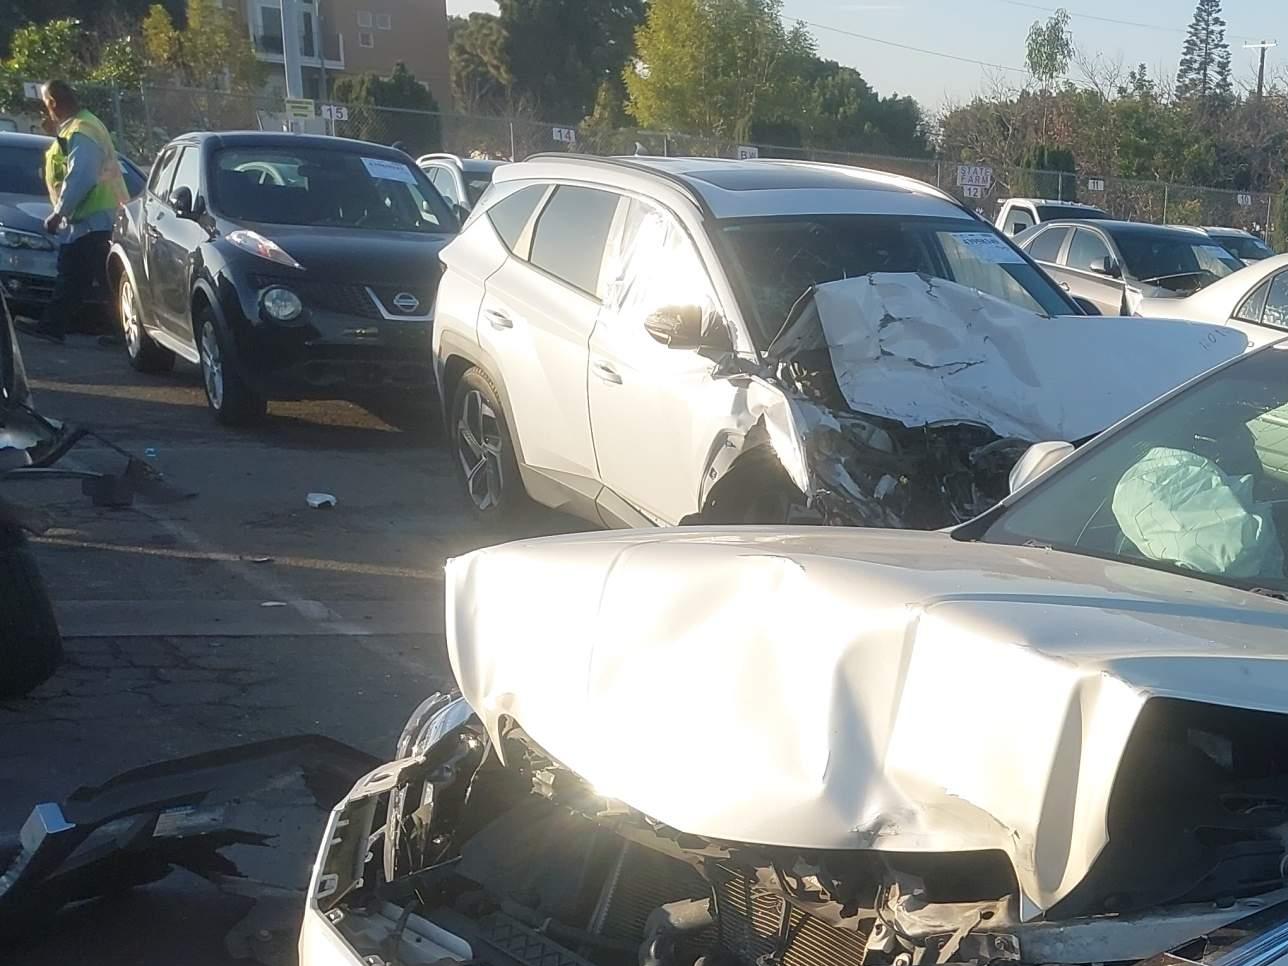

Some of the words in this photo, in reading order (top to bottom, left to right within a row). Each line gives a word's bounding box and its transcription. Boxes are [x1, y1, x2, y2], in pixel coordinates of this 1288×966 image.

[326, 107, 344, 119] 15
[960, 166, 991, 176] STATE
[967, 187, 979, 197] 12
